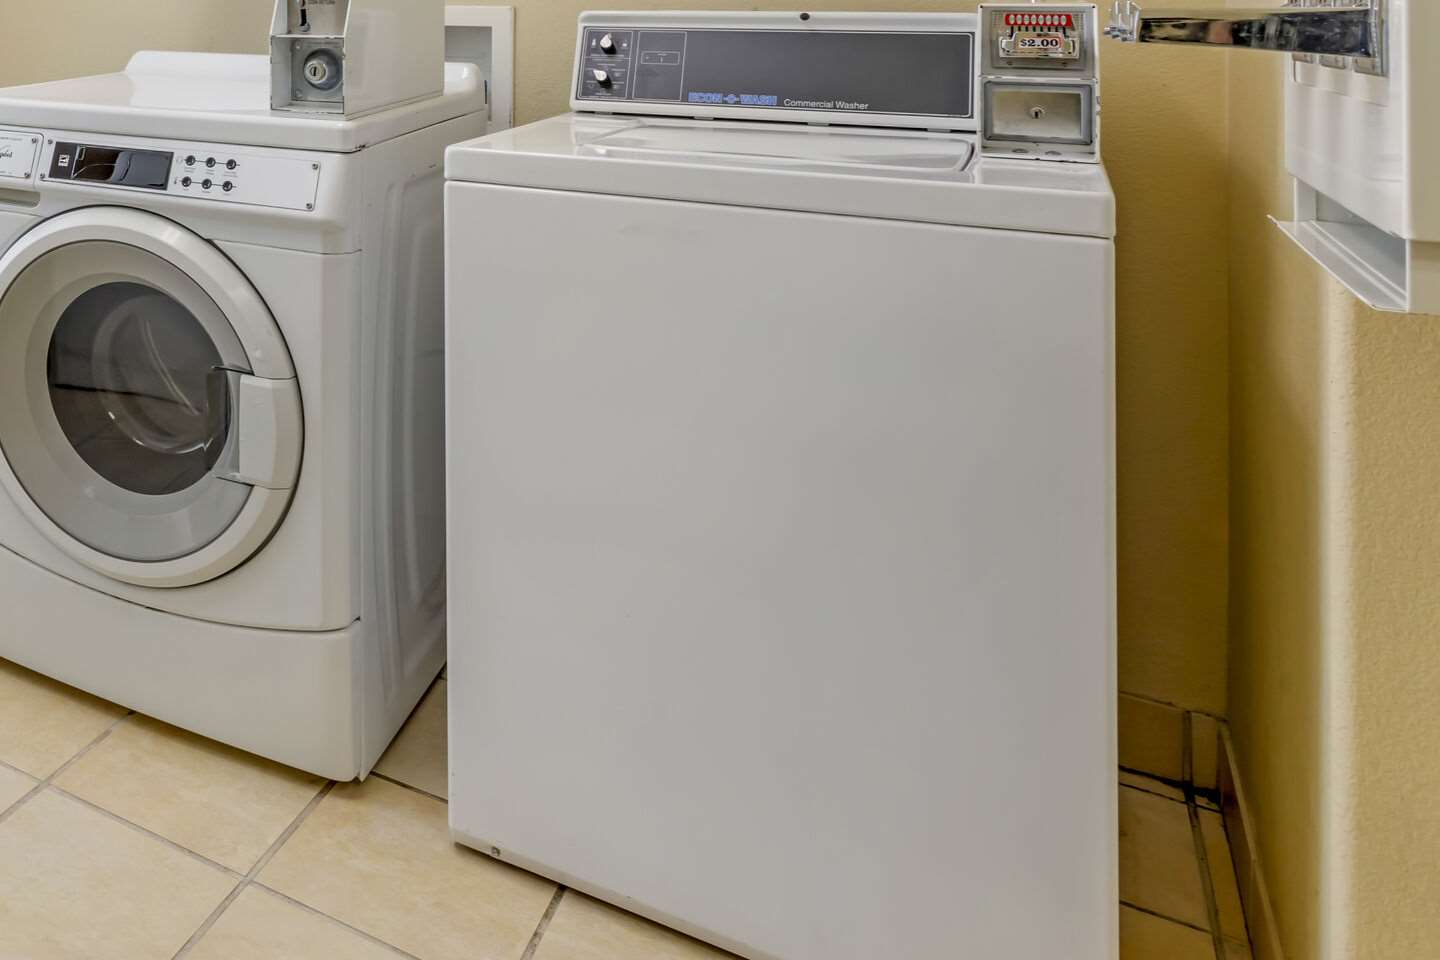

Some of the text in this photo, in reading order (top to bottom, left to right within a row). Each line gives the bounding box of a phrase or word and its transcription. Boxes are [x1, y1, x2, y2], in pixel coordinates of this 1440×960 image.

[1020, 38, 1059, 47] $2.00
[783, 98, 869, 110] Commercial Washer
